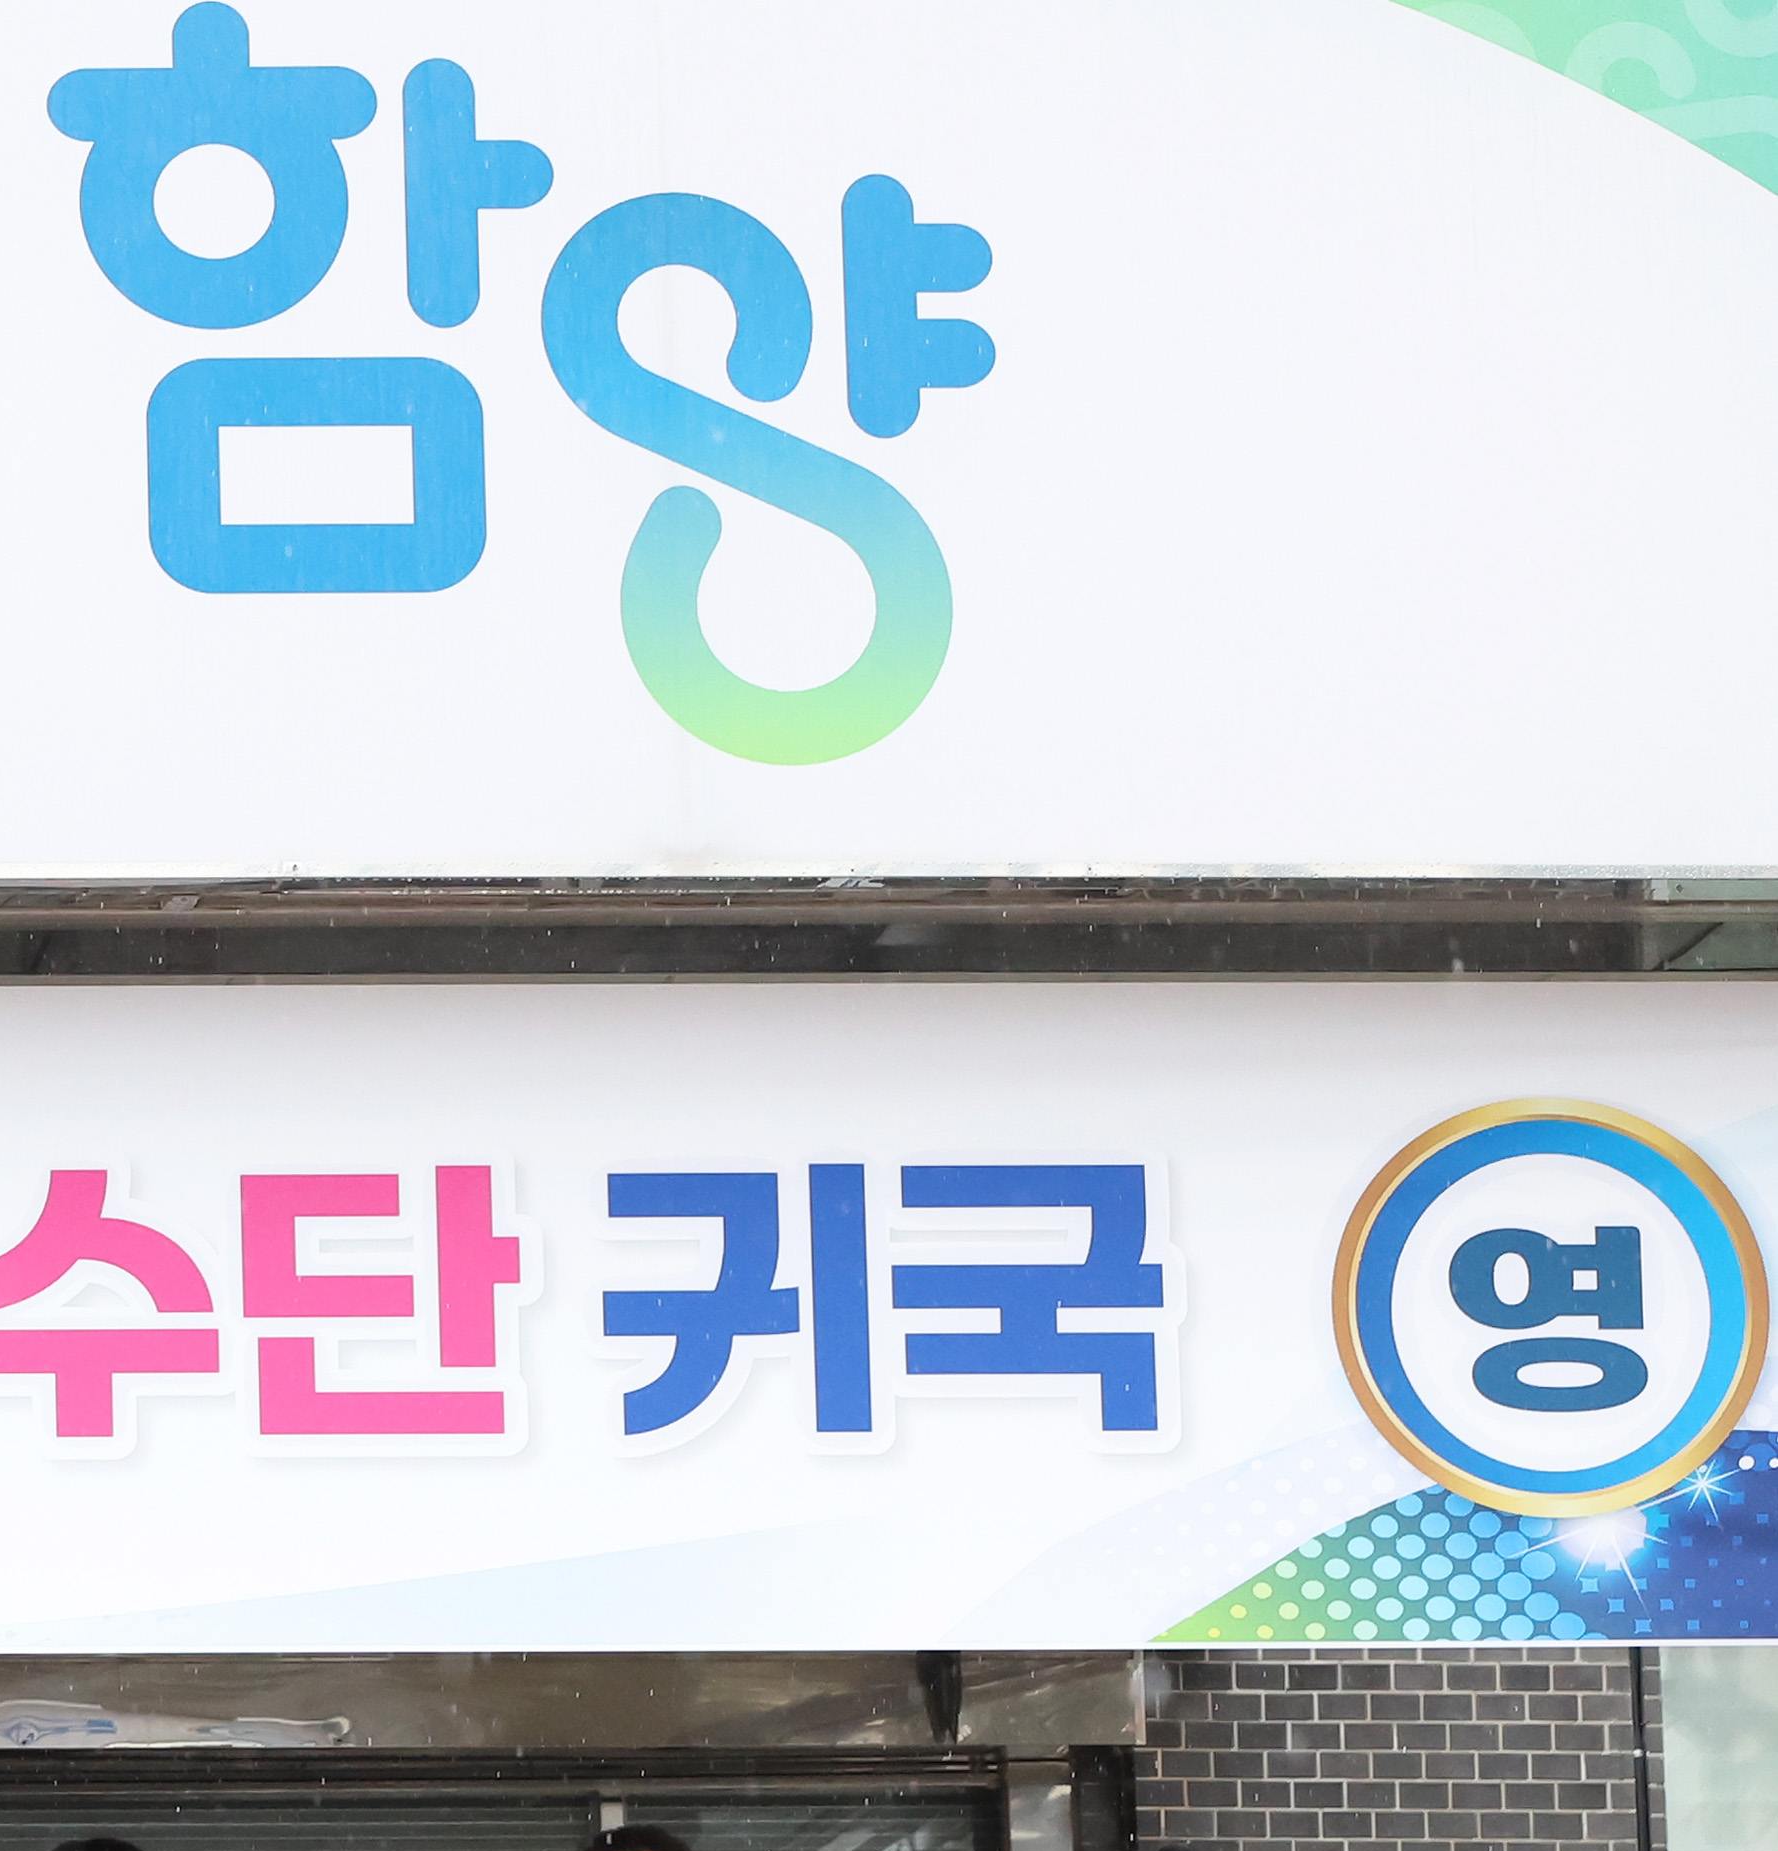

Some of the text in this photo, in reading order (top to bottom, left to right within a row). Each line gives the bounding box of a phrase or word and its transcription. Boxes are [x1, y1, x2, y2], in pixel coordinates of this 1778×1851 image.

[46, 0, 998, 766] 함양
[602, 1162, 1165, 1436] 귀국
[1447, 1225, 1650, 1413] 영
